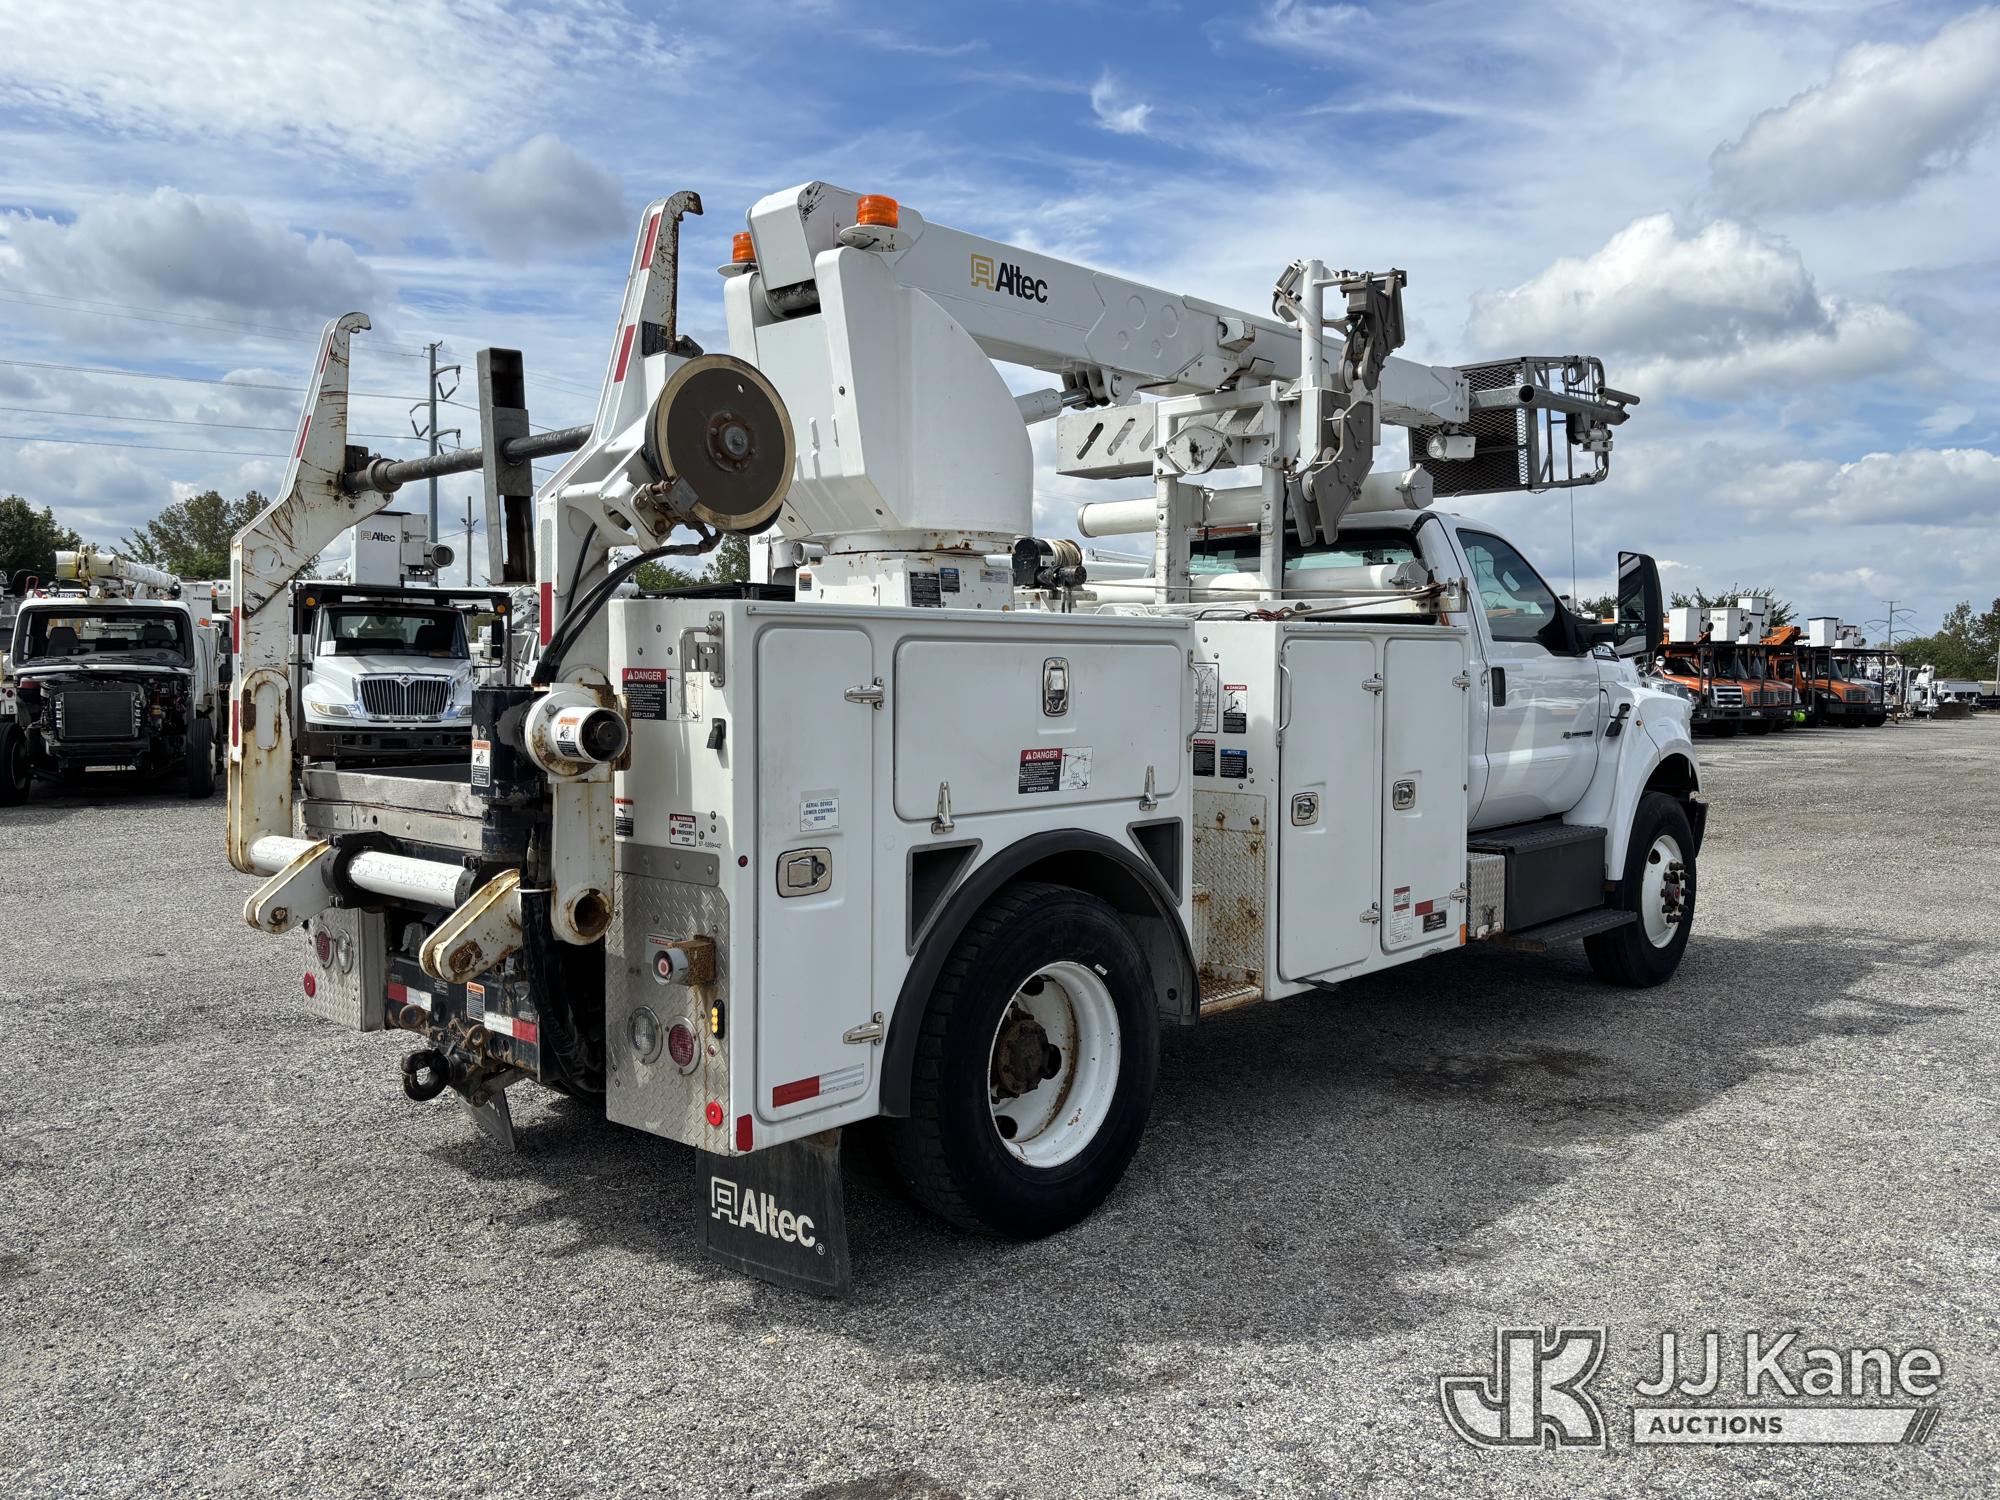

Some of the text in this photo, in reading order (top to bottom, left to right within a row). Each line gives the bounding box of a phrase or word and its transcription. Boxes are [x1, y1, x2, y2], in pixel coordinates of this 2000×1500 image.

[995, 262, 1048, 303] Altec
[372, 531, 395, 542] Altec
[634, 671, 662, 680] DANGER
[1032, 750, 1058, 760] DANGER
[739, 1188, 816, 1248] Altec
